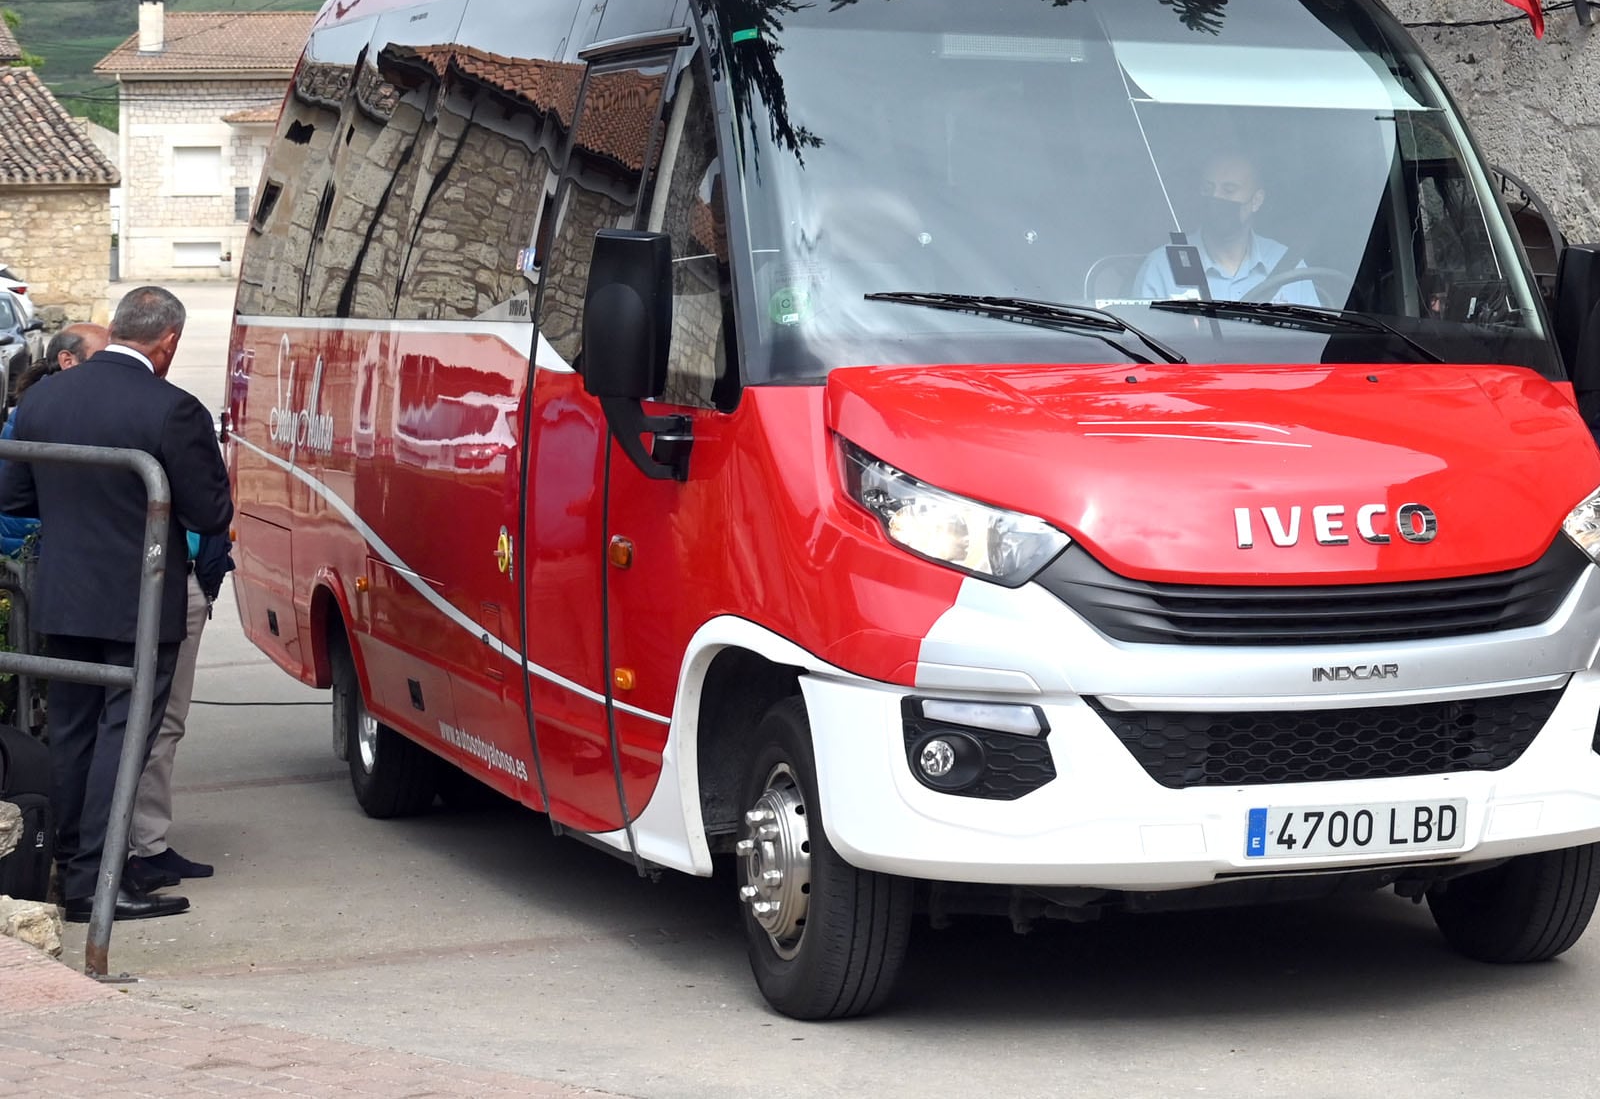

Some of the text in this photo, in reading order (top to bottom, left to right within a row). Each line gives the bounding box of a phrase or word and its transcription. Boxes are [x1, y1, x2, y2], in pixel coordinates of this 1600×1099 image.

[296, 353, 334, 451] Alonso
[1234, 502, 1438, 550] IVECO
[1312, 663, 1399, 682] INDCAR
[1251, 804, 1458, 850] E 4700 LBD
